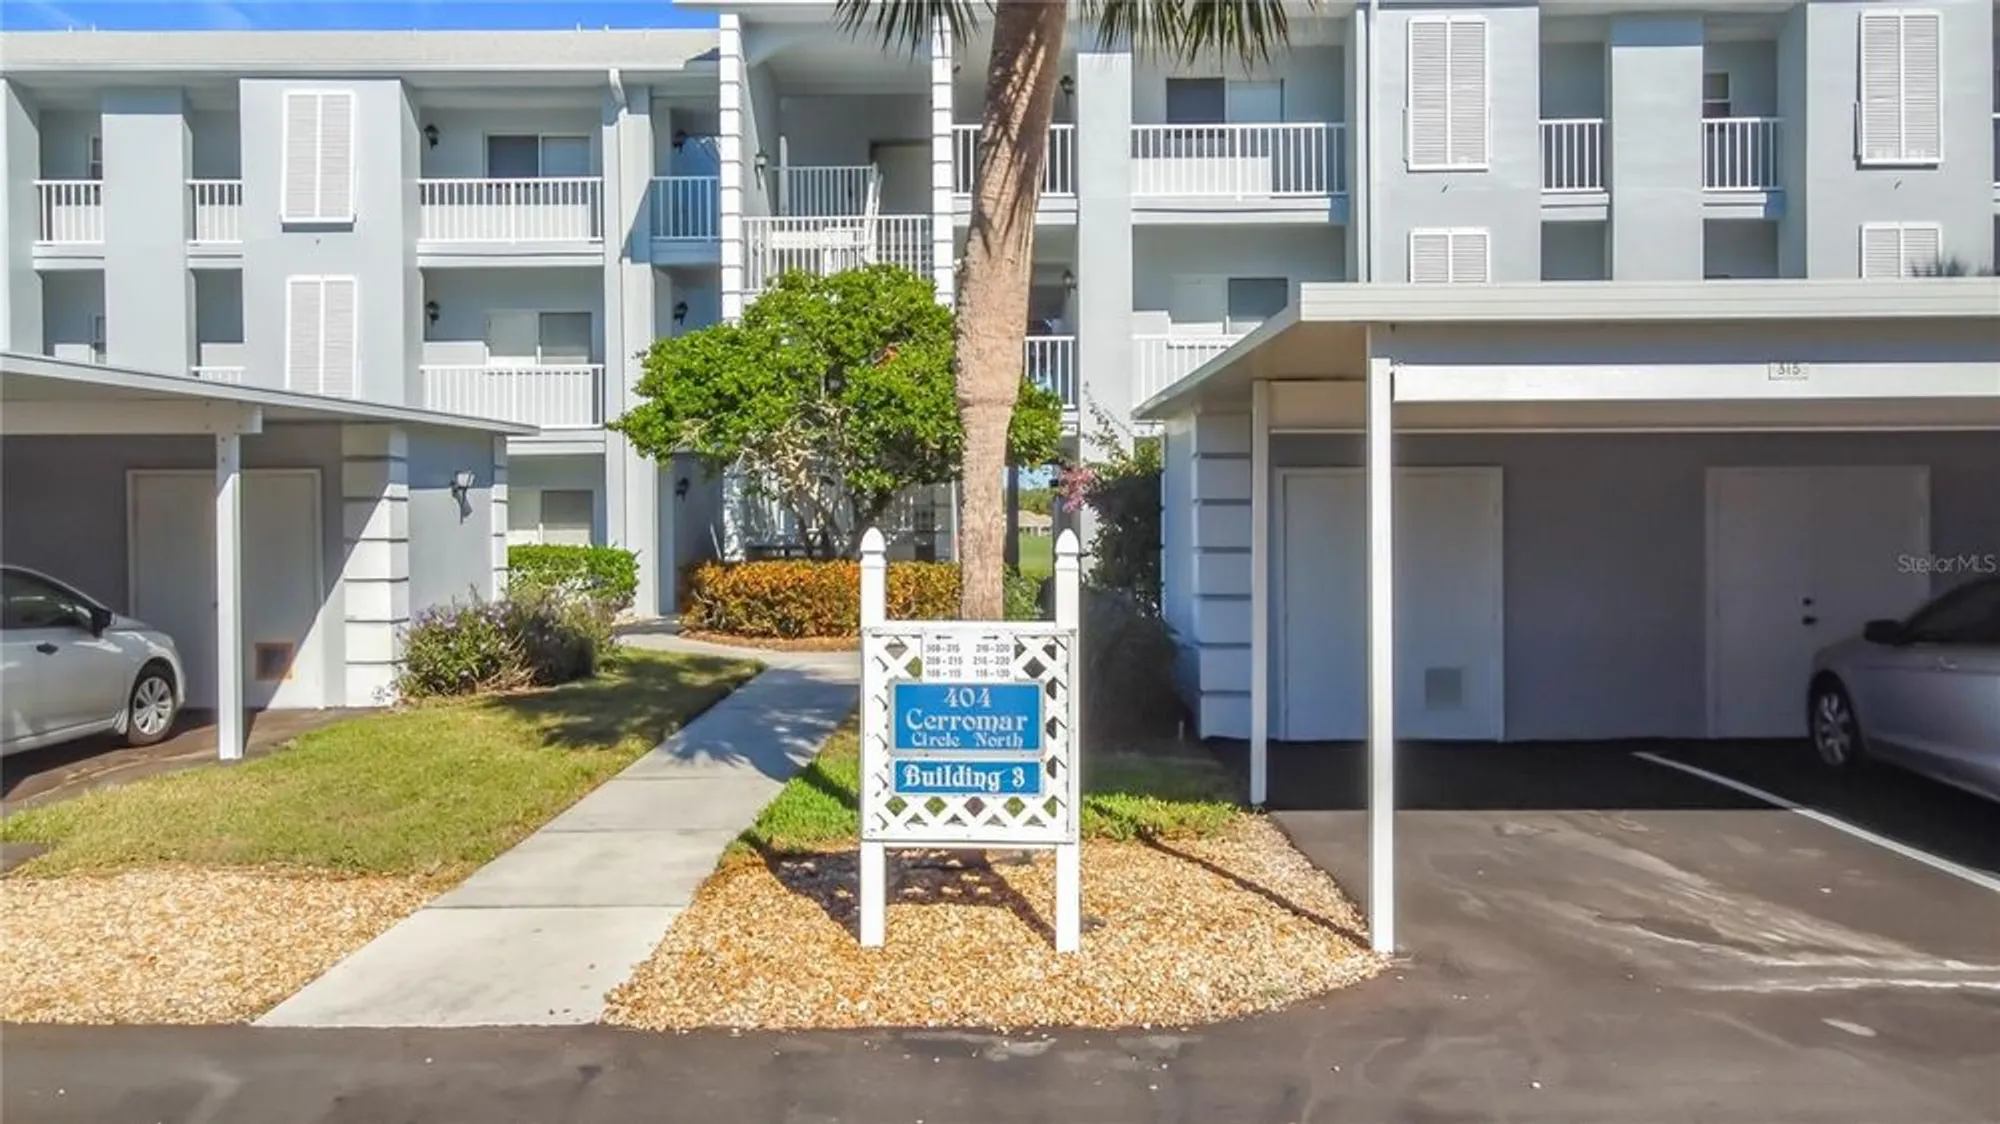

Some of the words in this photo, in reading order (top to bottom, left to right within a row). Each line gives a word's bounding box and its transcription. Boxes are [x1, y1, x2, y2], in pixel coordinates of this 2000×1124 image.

[943, 687, 992, 708] 404
[905, 707, 1029, 733] Cerromar
[911, 731, 961, 747] Circle
[973, 731, 1024, 747] North
[903, 764, 1009, 792] Building
[1012, 765, 1026, 788] 3
